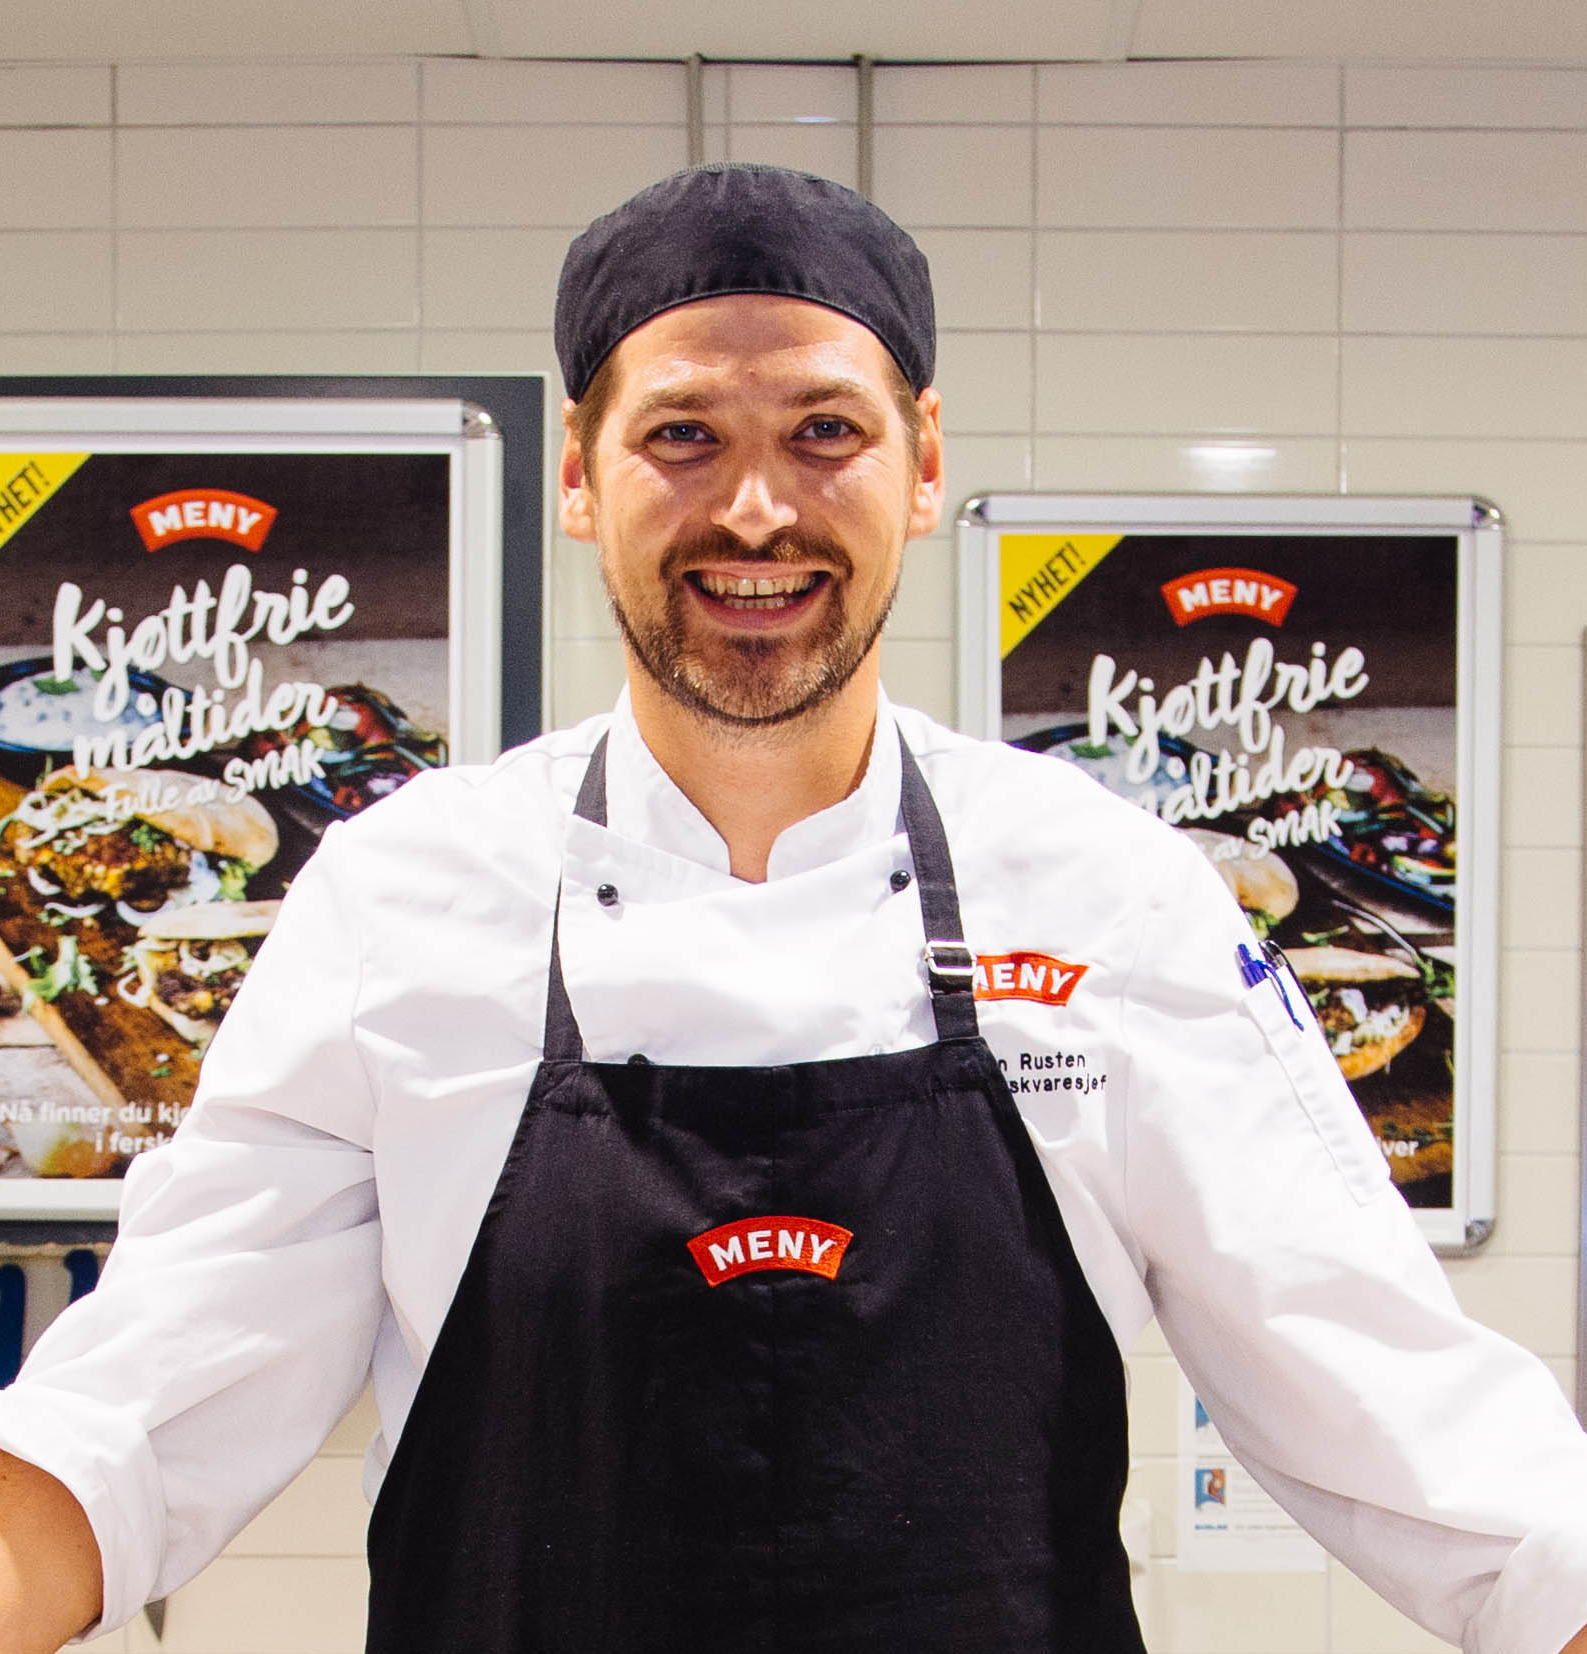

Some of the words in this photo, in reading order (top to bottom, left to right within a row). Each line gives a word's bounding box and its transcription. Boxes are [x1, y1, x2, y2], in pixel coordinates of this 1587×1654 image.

[147, 500, 263, 537] MENY
[1008, 540, 1087, 625] NYHET!
[1177, 577, 1284, 613] MENY
[51, 563, 356, 722] Kjøttfrie
[72, 656, 339, 780] måltider
[1087, 637, 1370, 785] Kjøttfrie
[223, 738, 327, 804] SMAK
[1247, 798, 1343, 861] SMAK
[1009, 1073, 1107, 1095] skvaresjef
[1020, 1051, 1086, 1070] Rusten
[38, 1102, 112, 1125] finner
[118, 1102, 152, 1124] du
[707, 1229, 837, 1271] MENY
